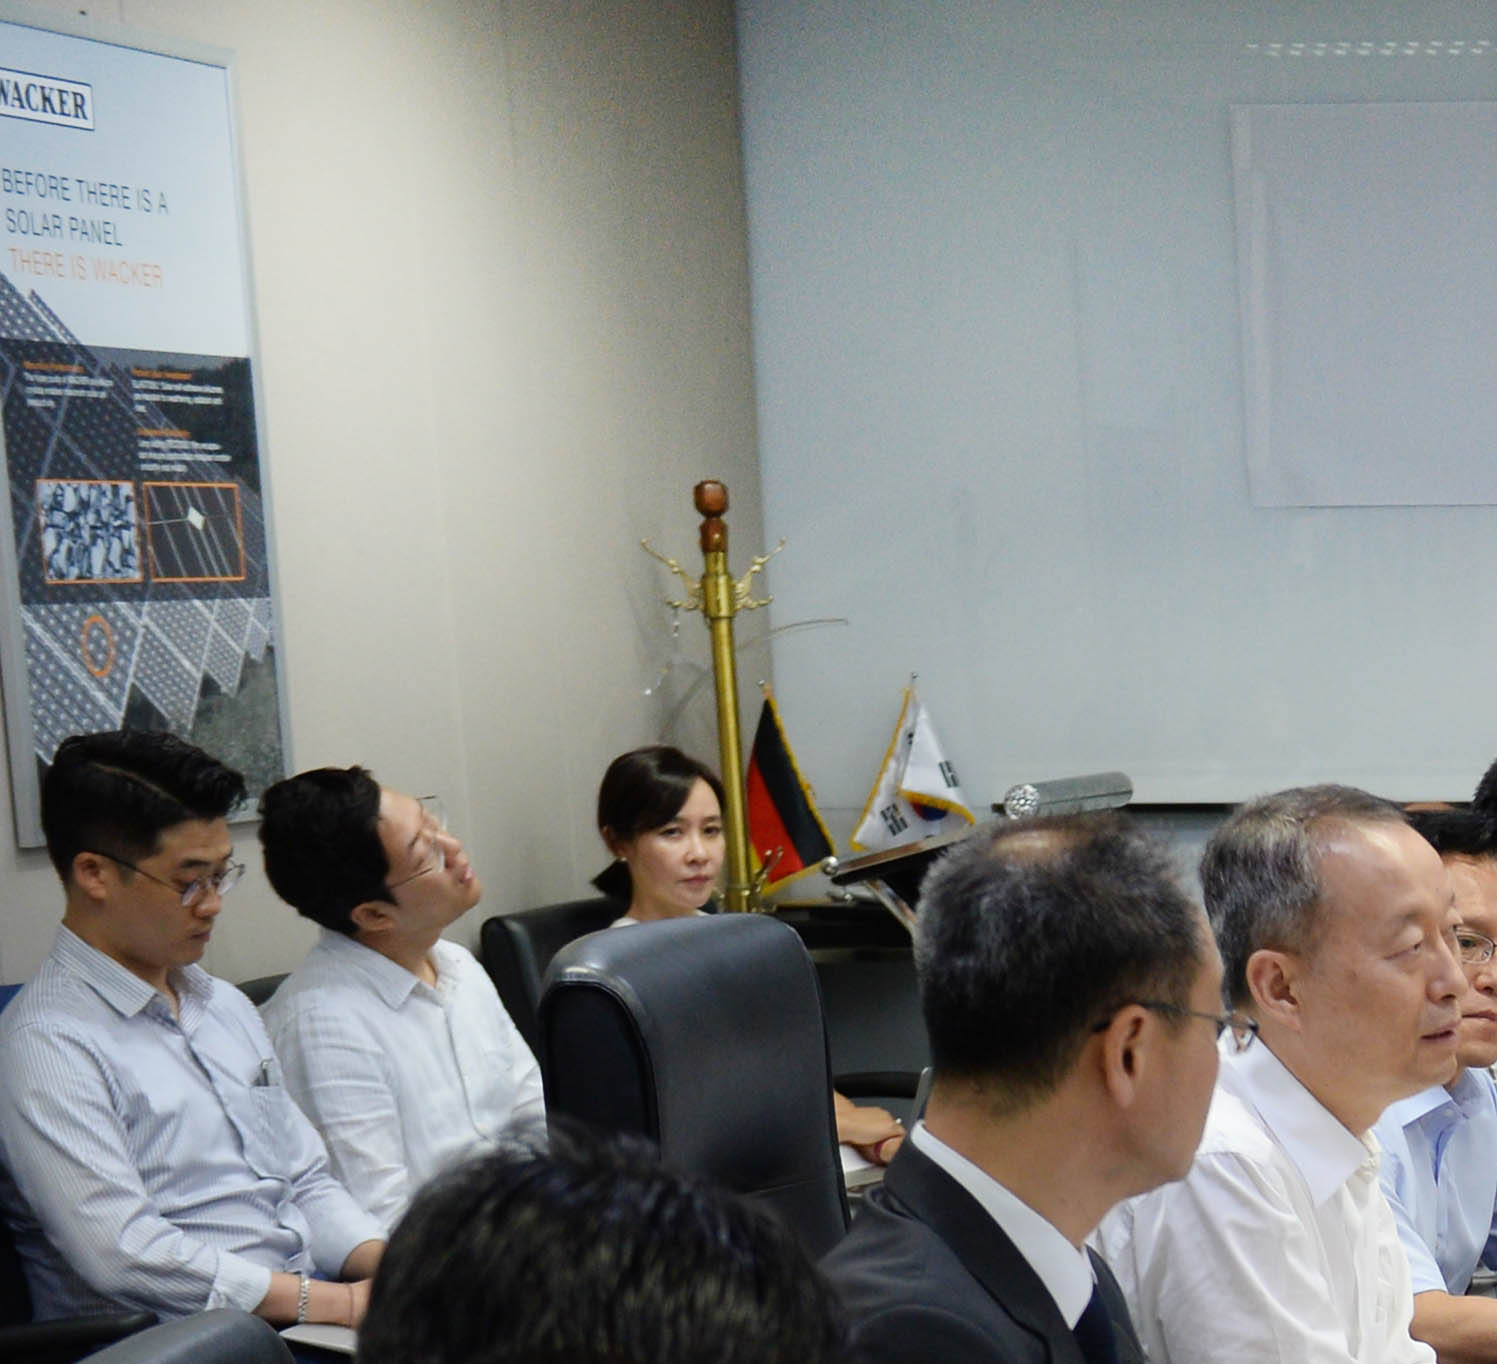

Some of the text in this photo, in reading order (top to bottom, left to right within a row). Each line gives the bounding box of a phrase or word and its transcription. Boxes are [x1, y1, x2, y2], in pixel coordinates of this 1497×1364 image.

[2, 167, 170, 215] BEFORE THERE IS A
[6, 207, 124, 247] SOLAR PANEL
[8, 247, 164, 289] THERE IS WACKER
